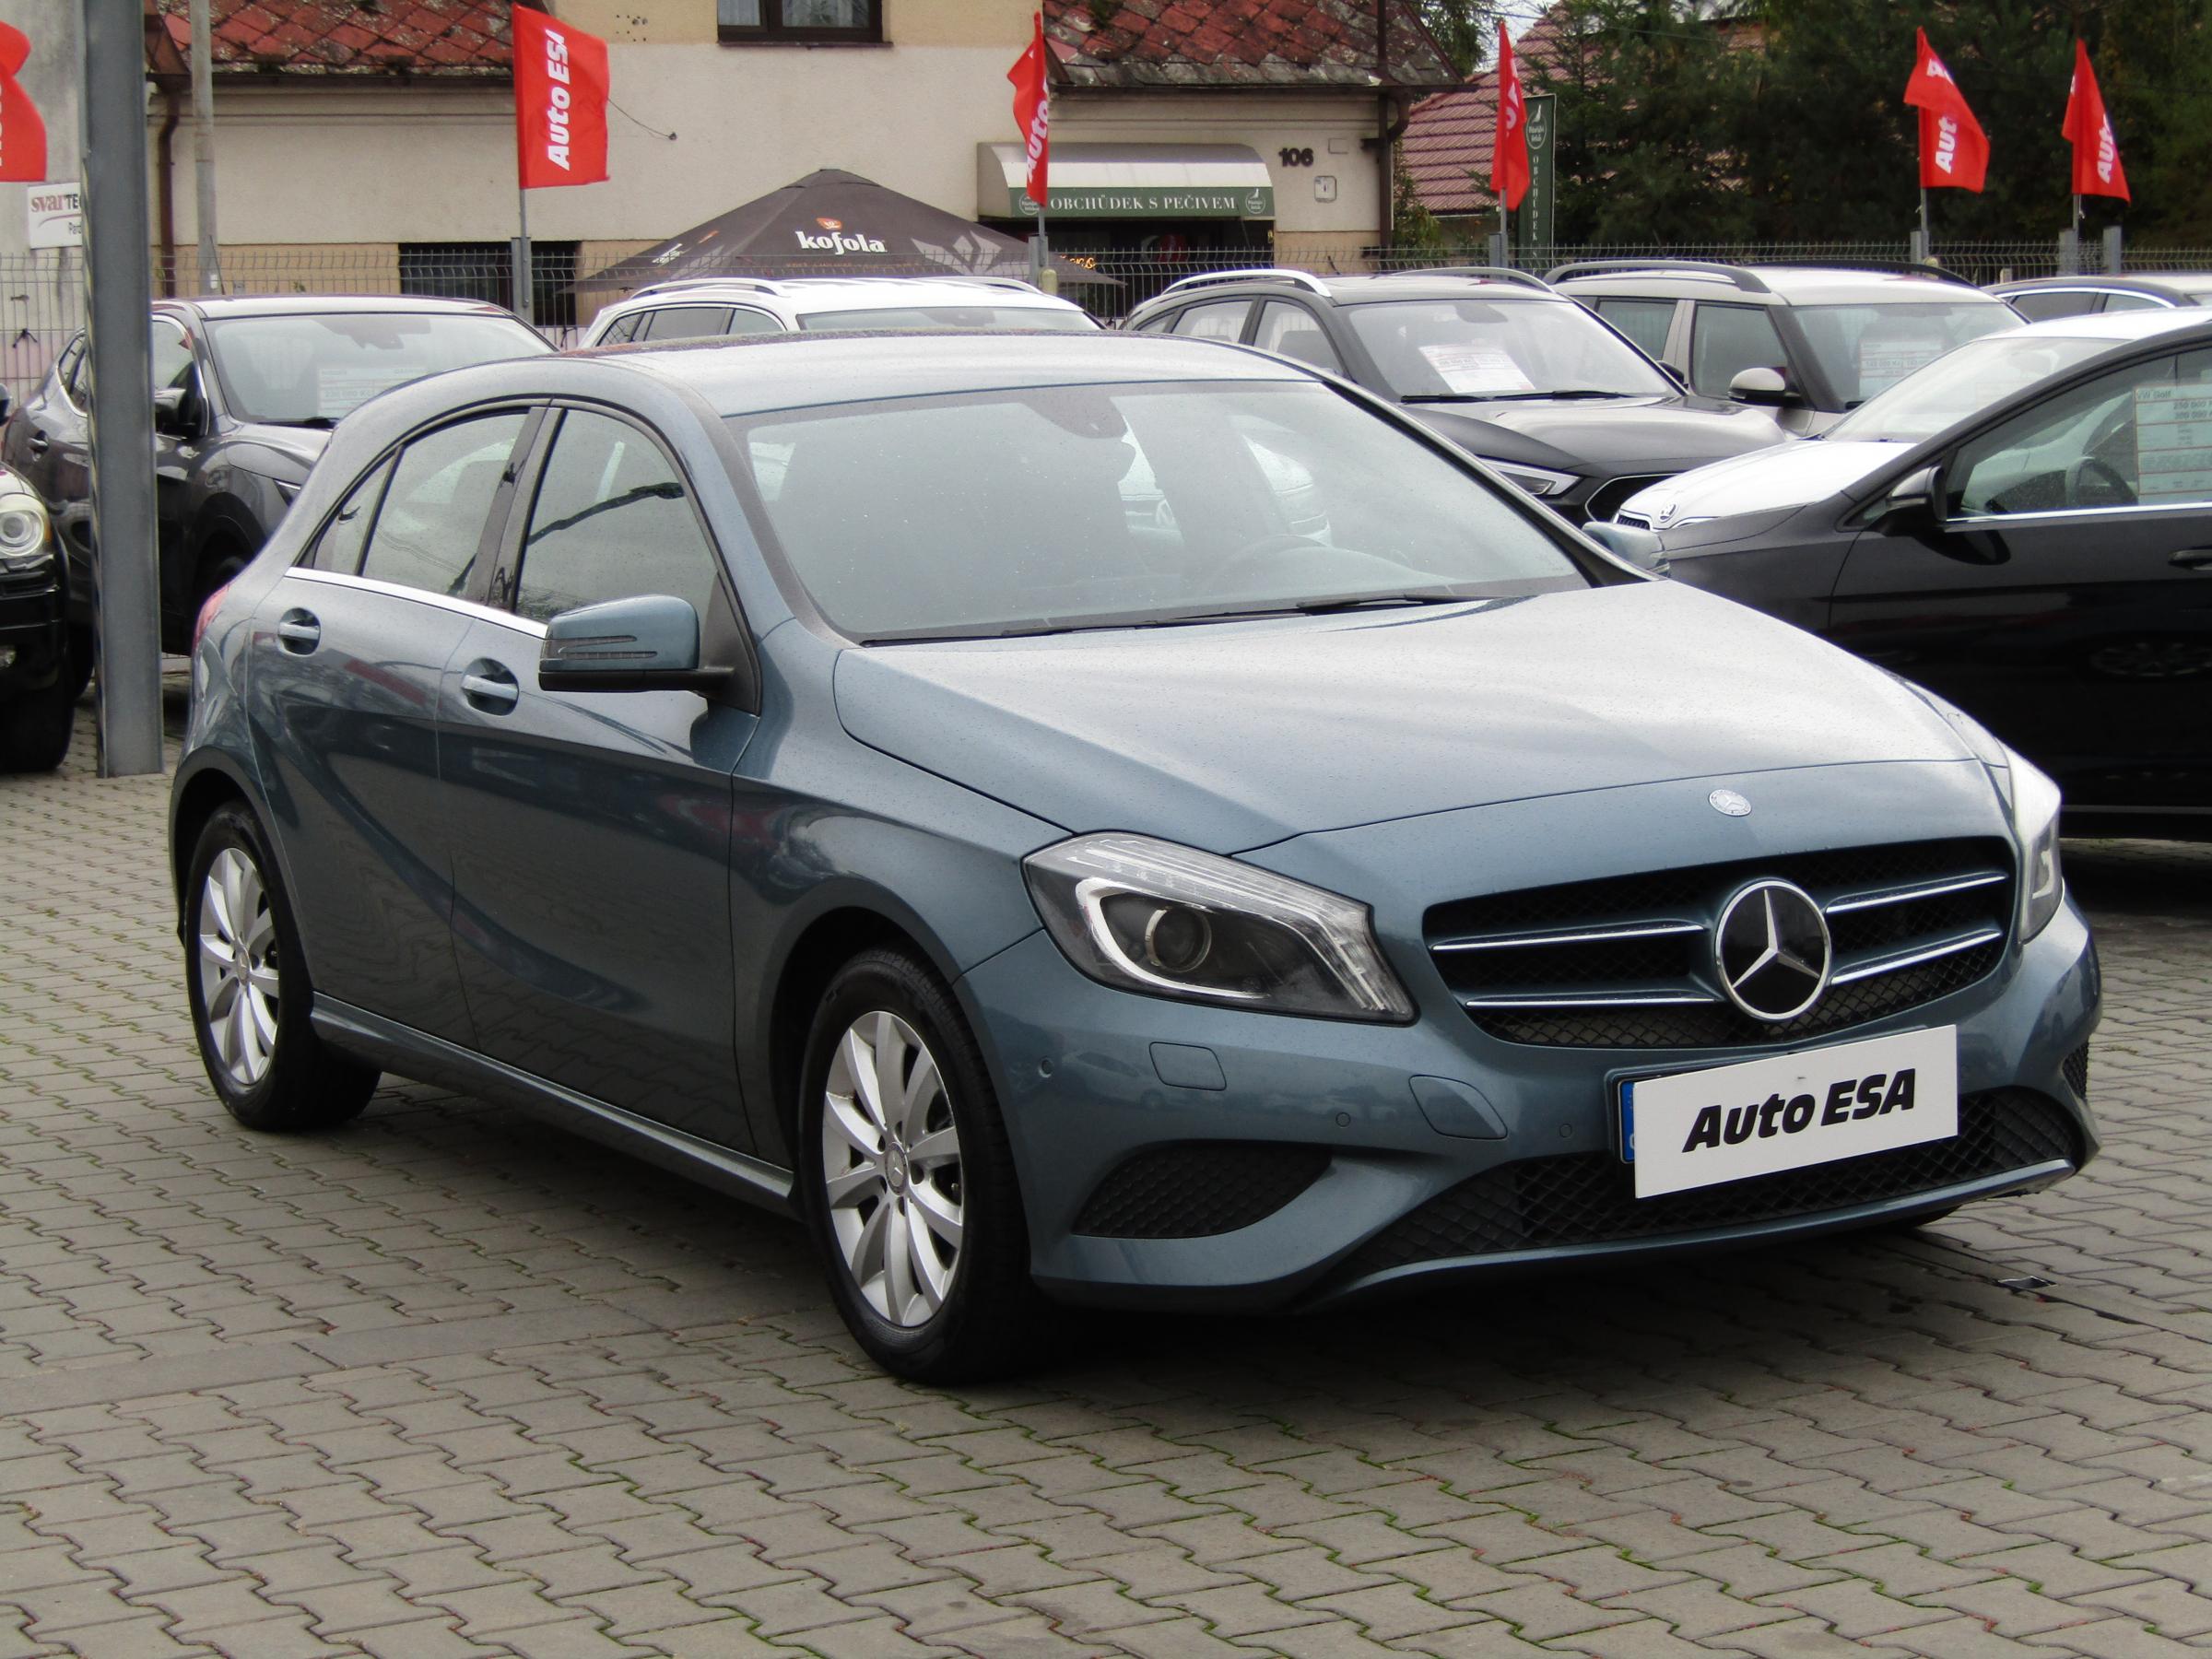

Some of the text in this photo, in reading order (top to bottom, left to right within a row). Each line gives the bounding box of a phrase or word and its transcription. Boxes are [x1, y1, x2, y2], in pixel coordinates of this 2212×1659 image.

[547, 87, 571, 171] Auto
[1936, 116, 1958, 174] Aut
[2097, 114, 2114, 183] Aut
[1278, 147, 1313, 167] 106
[31, 194, 81, 212] svarTE
[1051, 194, 1143, 210] OBCHŮDEK
[1148, 197, 1159, 209] S
[1164, 194, 1235, 209] PEČIVEM
[795, 231, 888, 255] kofola
[1682, 1067, 1916, 1153] Auto ESA
